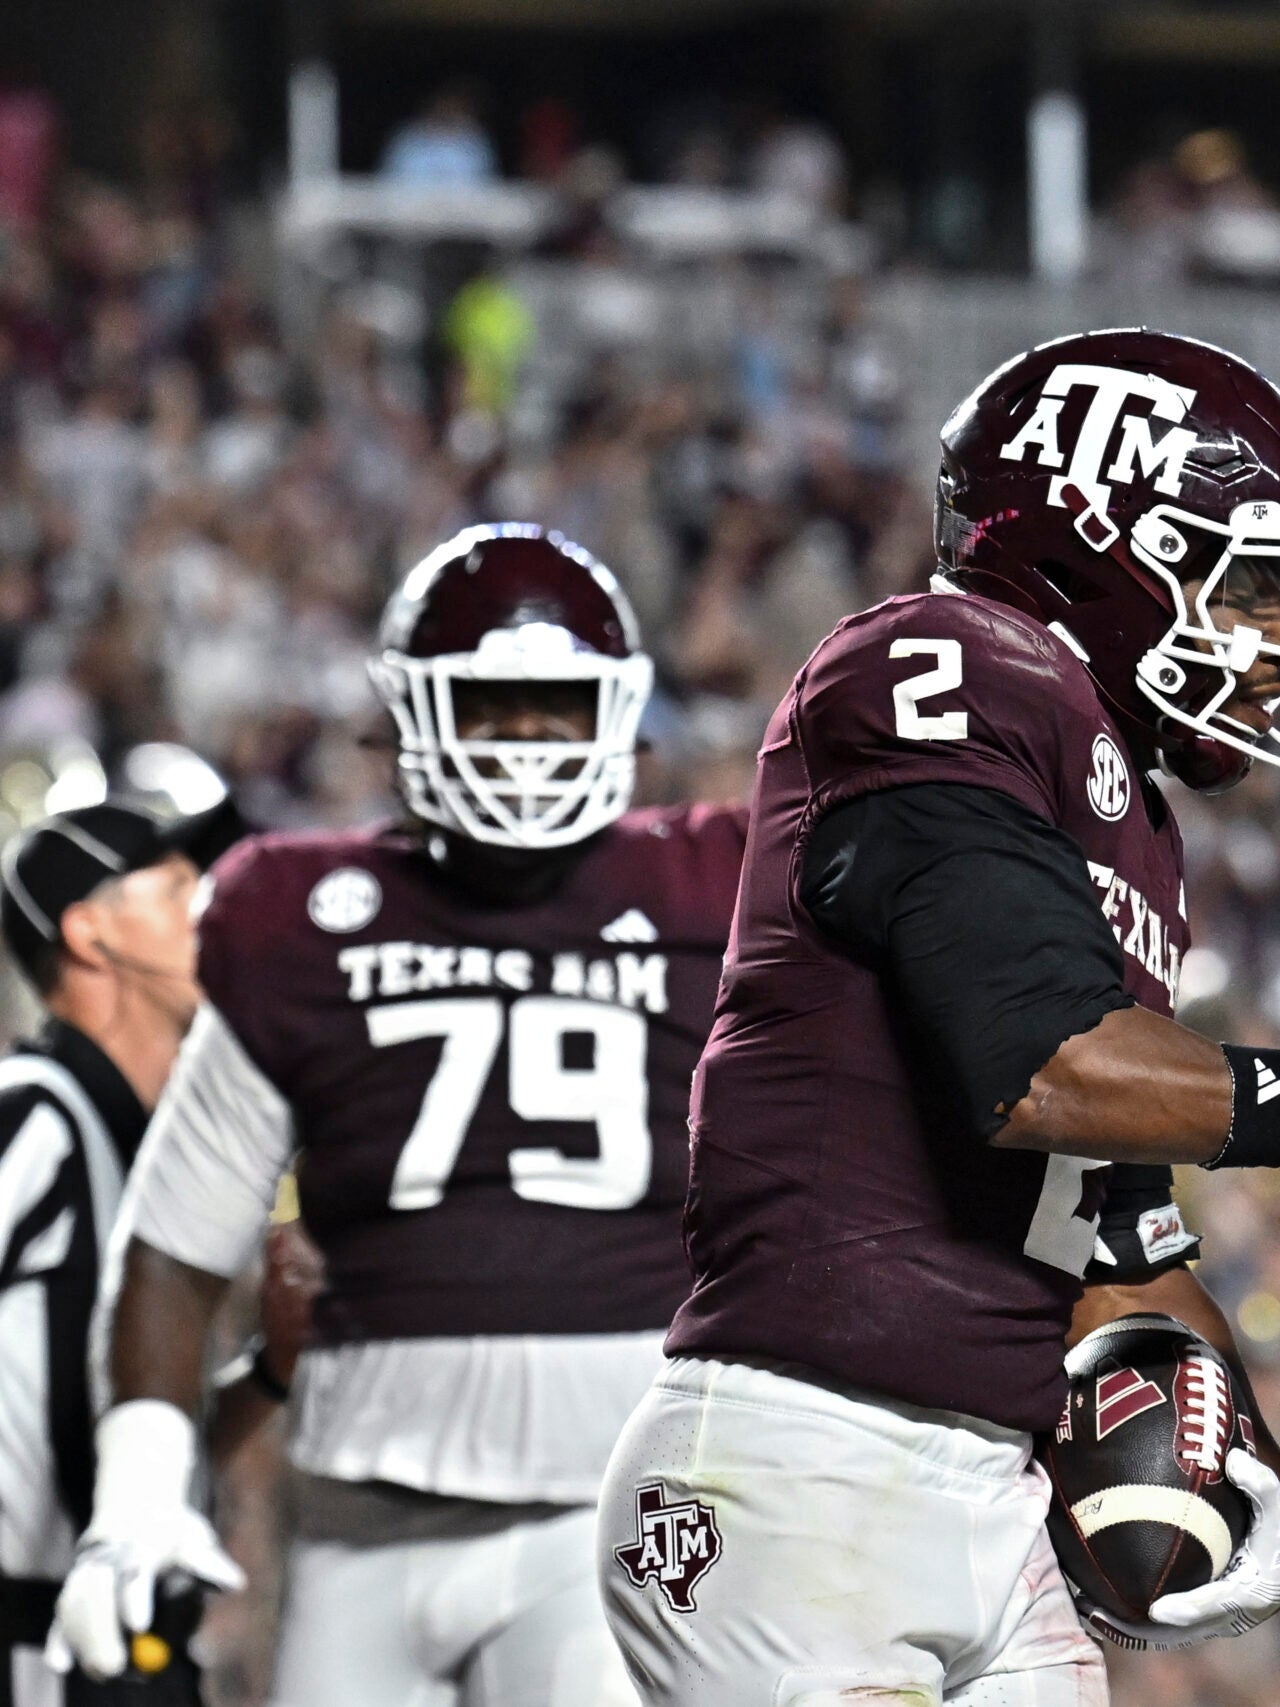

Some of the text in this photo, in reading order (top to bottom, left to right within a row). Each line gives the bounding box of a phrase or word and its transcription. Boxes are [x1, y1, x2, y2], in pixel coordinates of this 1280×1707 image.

[887, 638, 968, 741] 2
[1089, 741, 1126, 814] SEC
[337, 941, 533, 1002] TEXAS
[365, 996, 655, 1211] 79
